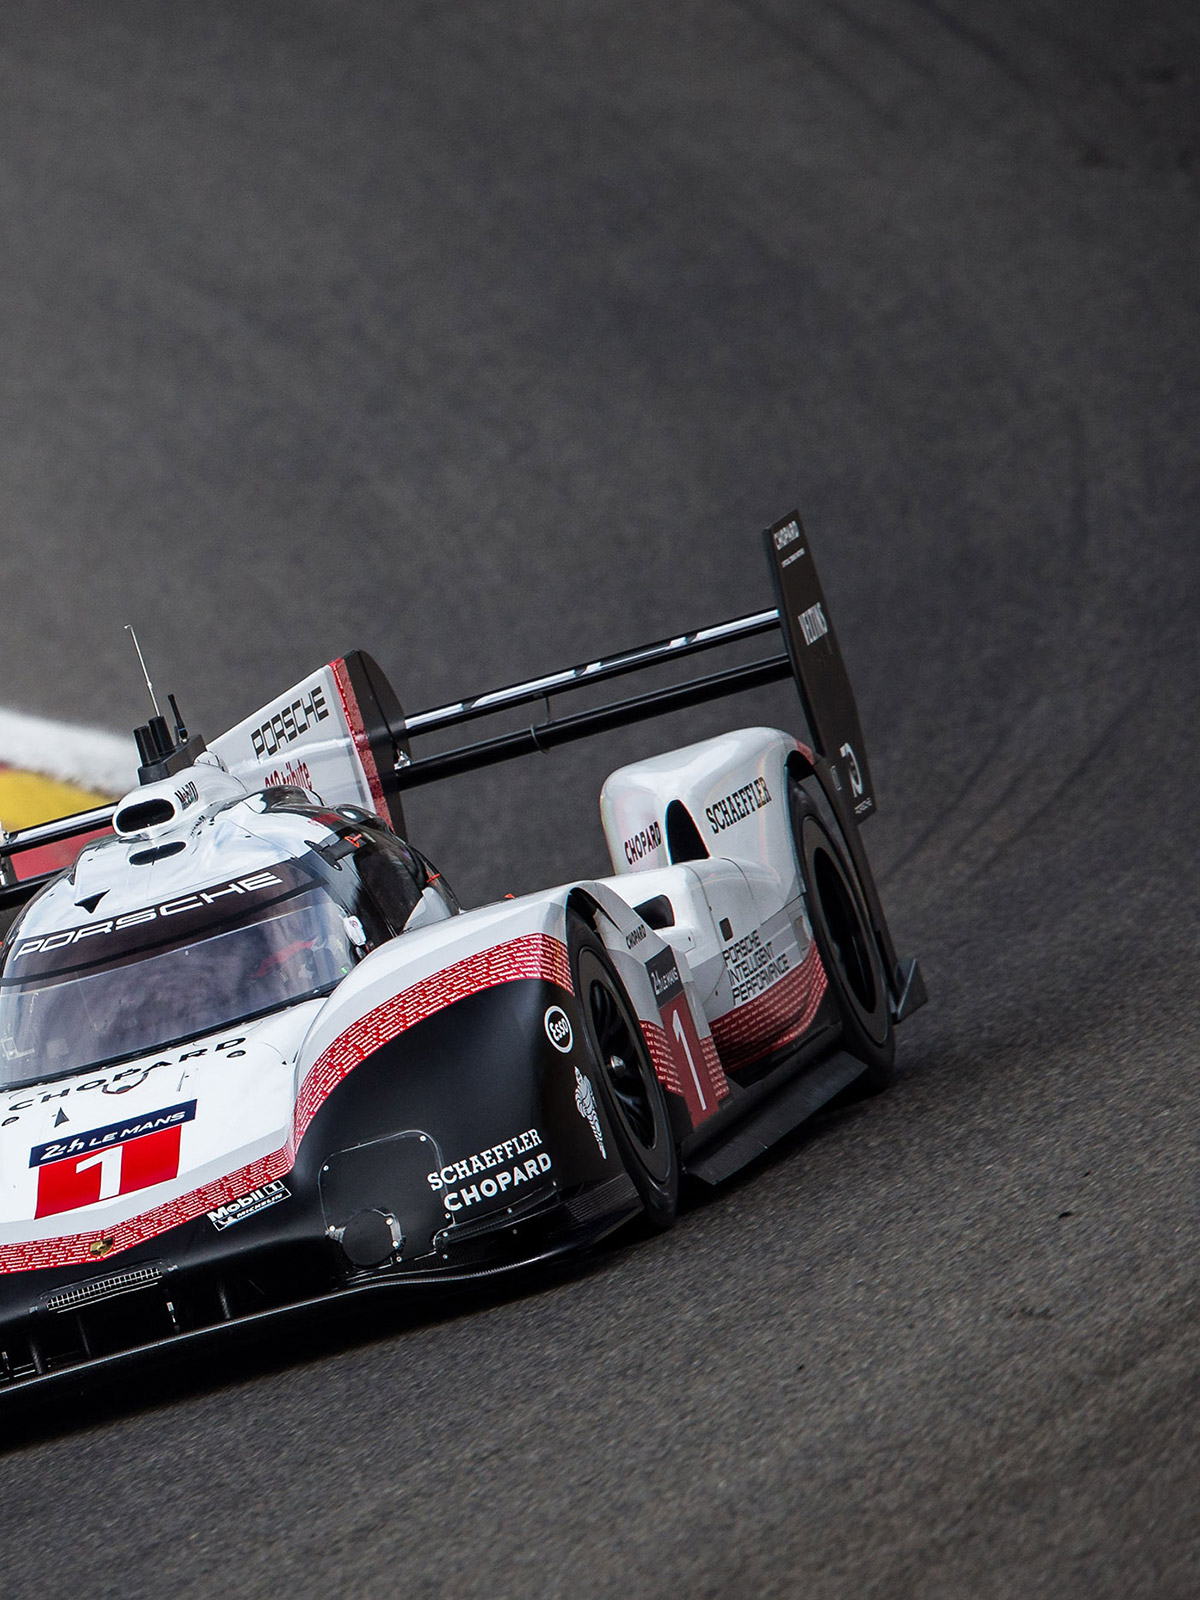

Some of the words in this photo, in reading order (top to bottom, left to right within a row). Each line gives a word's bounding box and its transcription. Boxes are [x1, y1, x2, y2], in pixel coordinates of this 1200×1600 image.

[251, 686, 329, 764] PORSCHE
[706, 776, 772, 834] SCHAEFFLER
[625, 821, 662, 865] CHOPARD
[13, 871, 283, 961] PORSCHE
[722, 930, 761, 967] PORSCHE
[728, 941, 774, 987] INTELLIGENT
[732, 953, 790, 1006] PERFORMANCE
[8, 1037, 247, 1112] CHOPARD
[672, 1008, 707, 1112] 1
[88, 1131, 118, 1147] LE
[120, 1111, 186, 1138] MANS
[75, 1145, 124, 1201] 1
[427, 1128, 543, 1191] SCHAEFFLER
[443, 1152, 552, 1212] CHOPARD
[206, 1189, 265, 1222] Mobil
[236, 1193, 283, 1218] MICHELIN
